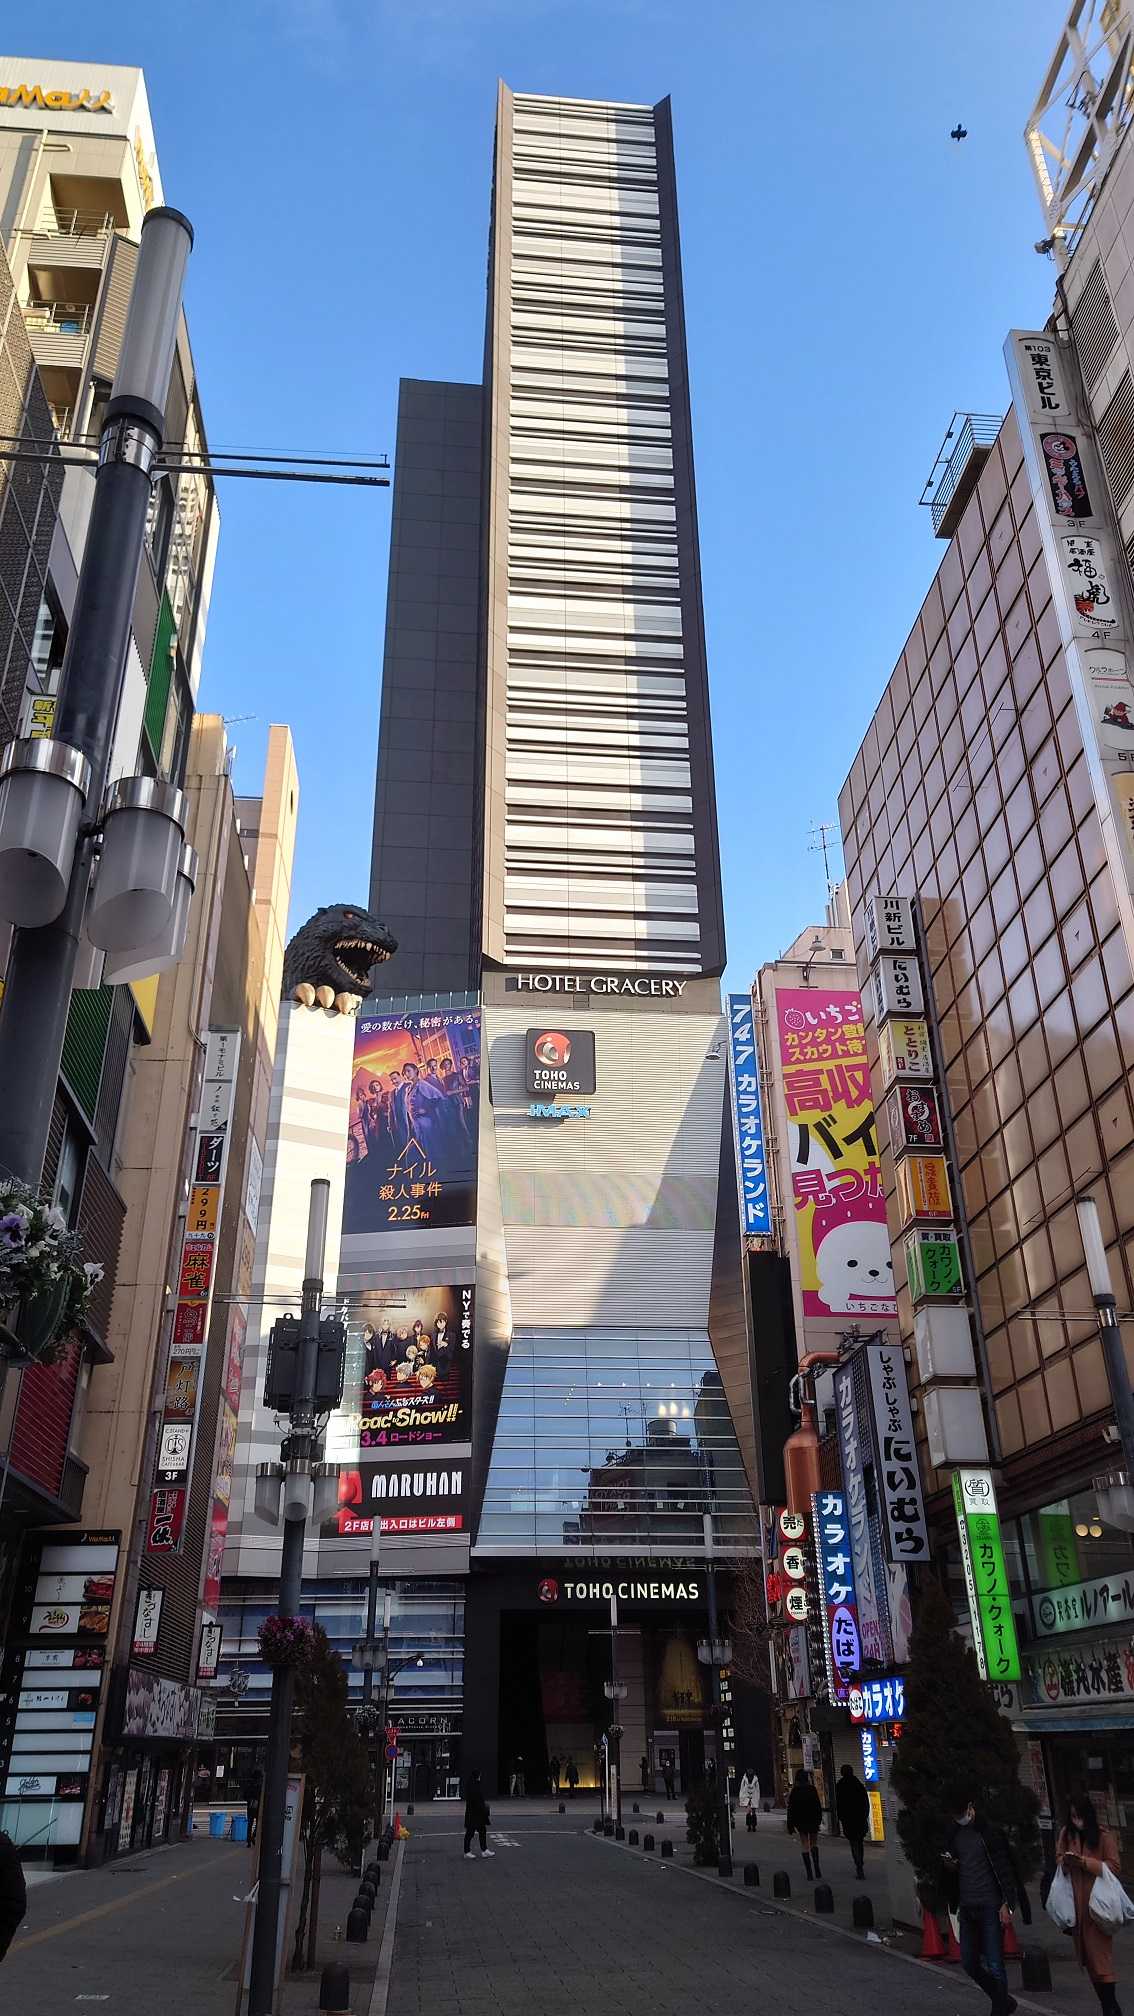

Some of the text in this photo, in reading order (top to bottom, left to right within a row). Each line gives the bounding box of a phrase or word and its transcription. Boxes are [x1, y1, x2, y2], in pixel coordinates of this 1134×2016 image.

[1030, 353, 1060, 410] 東京ビル
[884, 899, 906, 947] 川新ビル
[517, 973, 688, 996] HOTEL GRACERY
[892, 959, 912, 1009] にいむら
[360, 1015, 479, 1033] 愛の数だけ、秘密がある。
[804, 1001, 861, 1025] いちご
[788, 1039, 866, 1062] スカウト待
[903, 1025, 921, 1073] ととりこ
[533, 1070, 567, 1081] TOHO
[533, 1081, 580, 1090] CINEMAS
[732, 1004, 766, 1224] 747 カラオケランド
[907, 1134, 918, 1143] 7F
[207, 1136, 224, 1173] ダーツ
[386, 1161, 437, 1180] ナイル
[378, 1181, 443, 1200] 殺人事件
[183, 1252, 210, 1291] 麻雀
[360, 1430, 443, 1446] 3.4 ロードショー
[879, 1351, 925, 1555] しゃぶしゃぶ にいむら
[164, 1471, 178, 1480] 3F
[371, 1471, 463, 1498] MARUHAN
[821, 1494, 853, 1605] カラオケ
[564, 1583, 699, 1600] TOHO CINEMAS
[863, 1679, 905, 1719] カラオケ
[398, 1717, 449, 1725] ACORN
[861, 1731, 875, 1780] カラオケ
